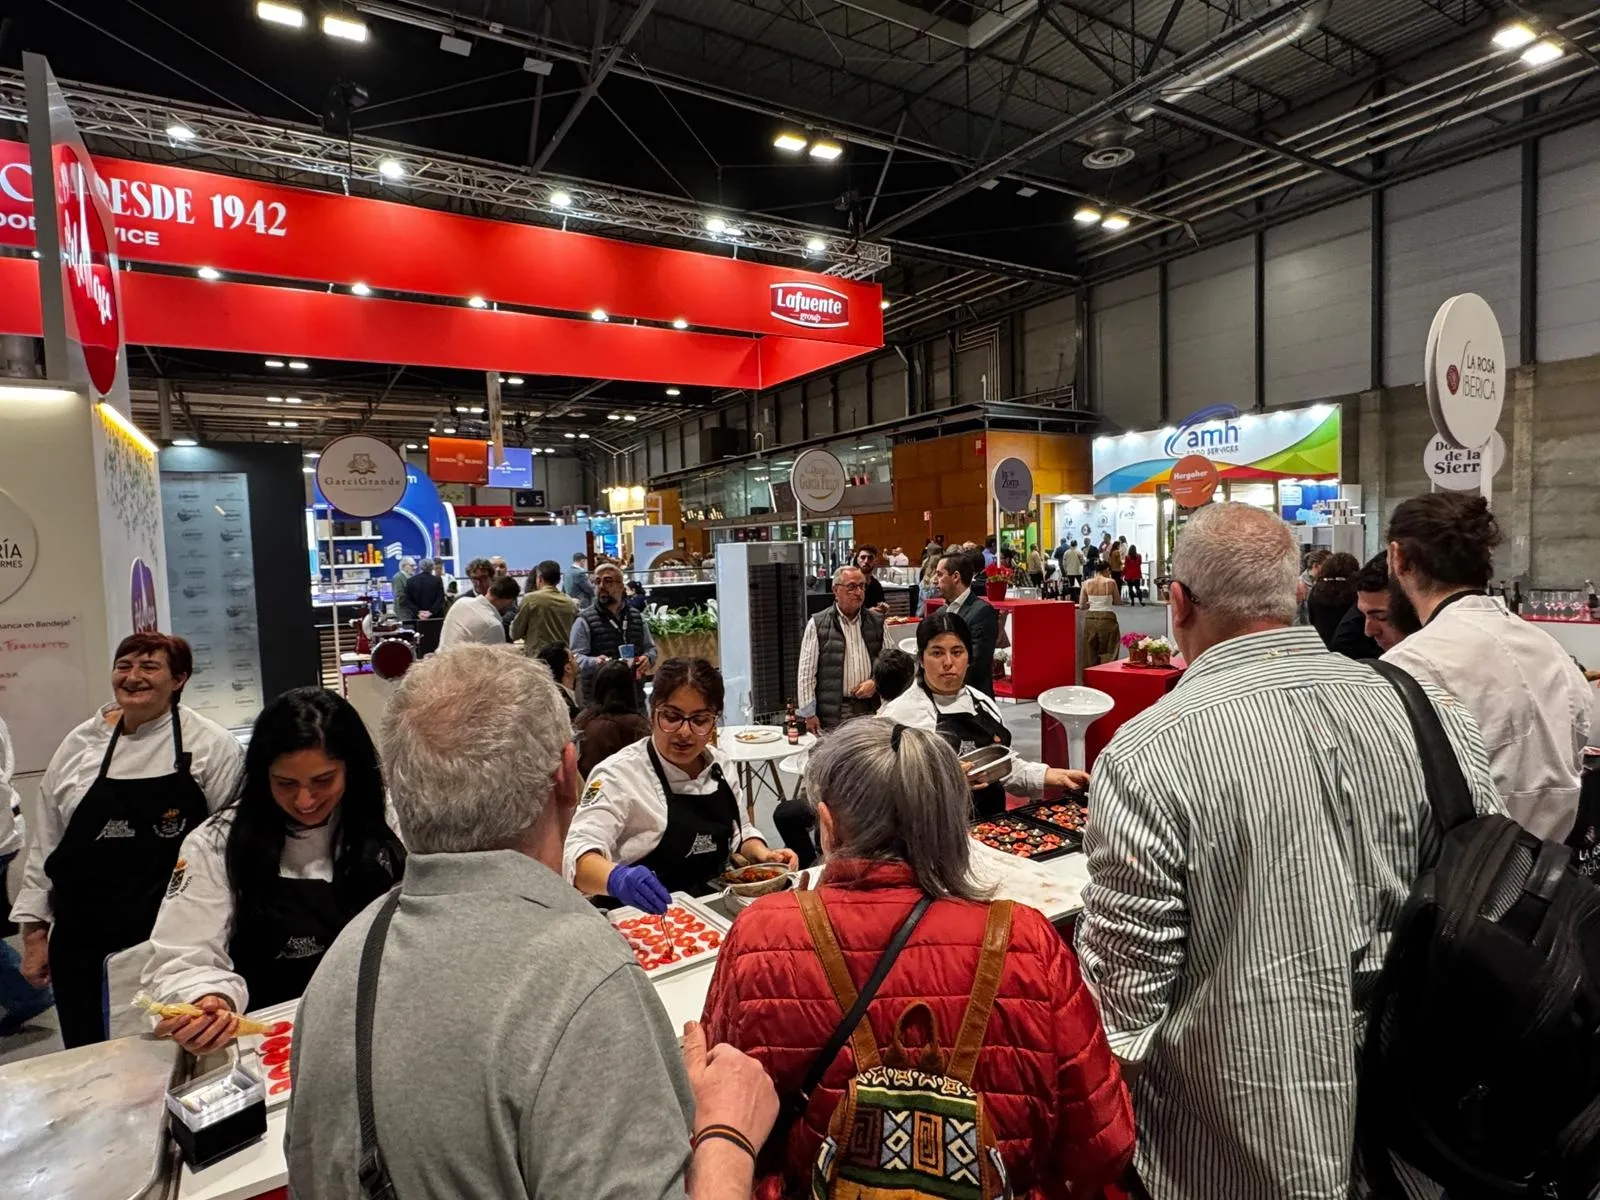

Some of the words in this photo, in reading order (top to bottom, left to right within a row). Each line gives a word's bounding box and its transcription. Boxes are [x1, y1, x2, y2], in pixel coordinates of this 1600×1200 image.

[210, 193, 288, 237] 1942
[776, 288, 842, 315] Lafuente
[799, 312, 822, 323] group
[1467, 355, 1475, 369] LA
[1477, 356, 1496, 374] ROSA
[1187, 420, 1239, 448] amh
[1445, 451, 1462, 461] de
[1467, 450, 1481, 460] la
[1434, 461, 1481, 475] Sierr
[324, 477, 400, 486] GarciGrande
[535, 495, 542, 505] 5
